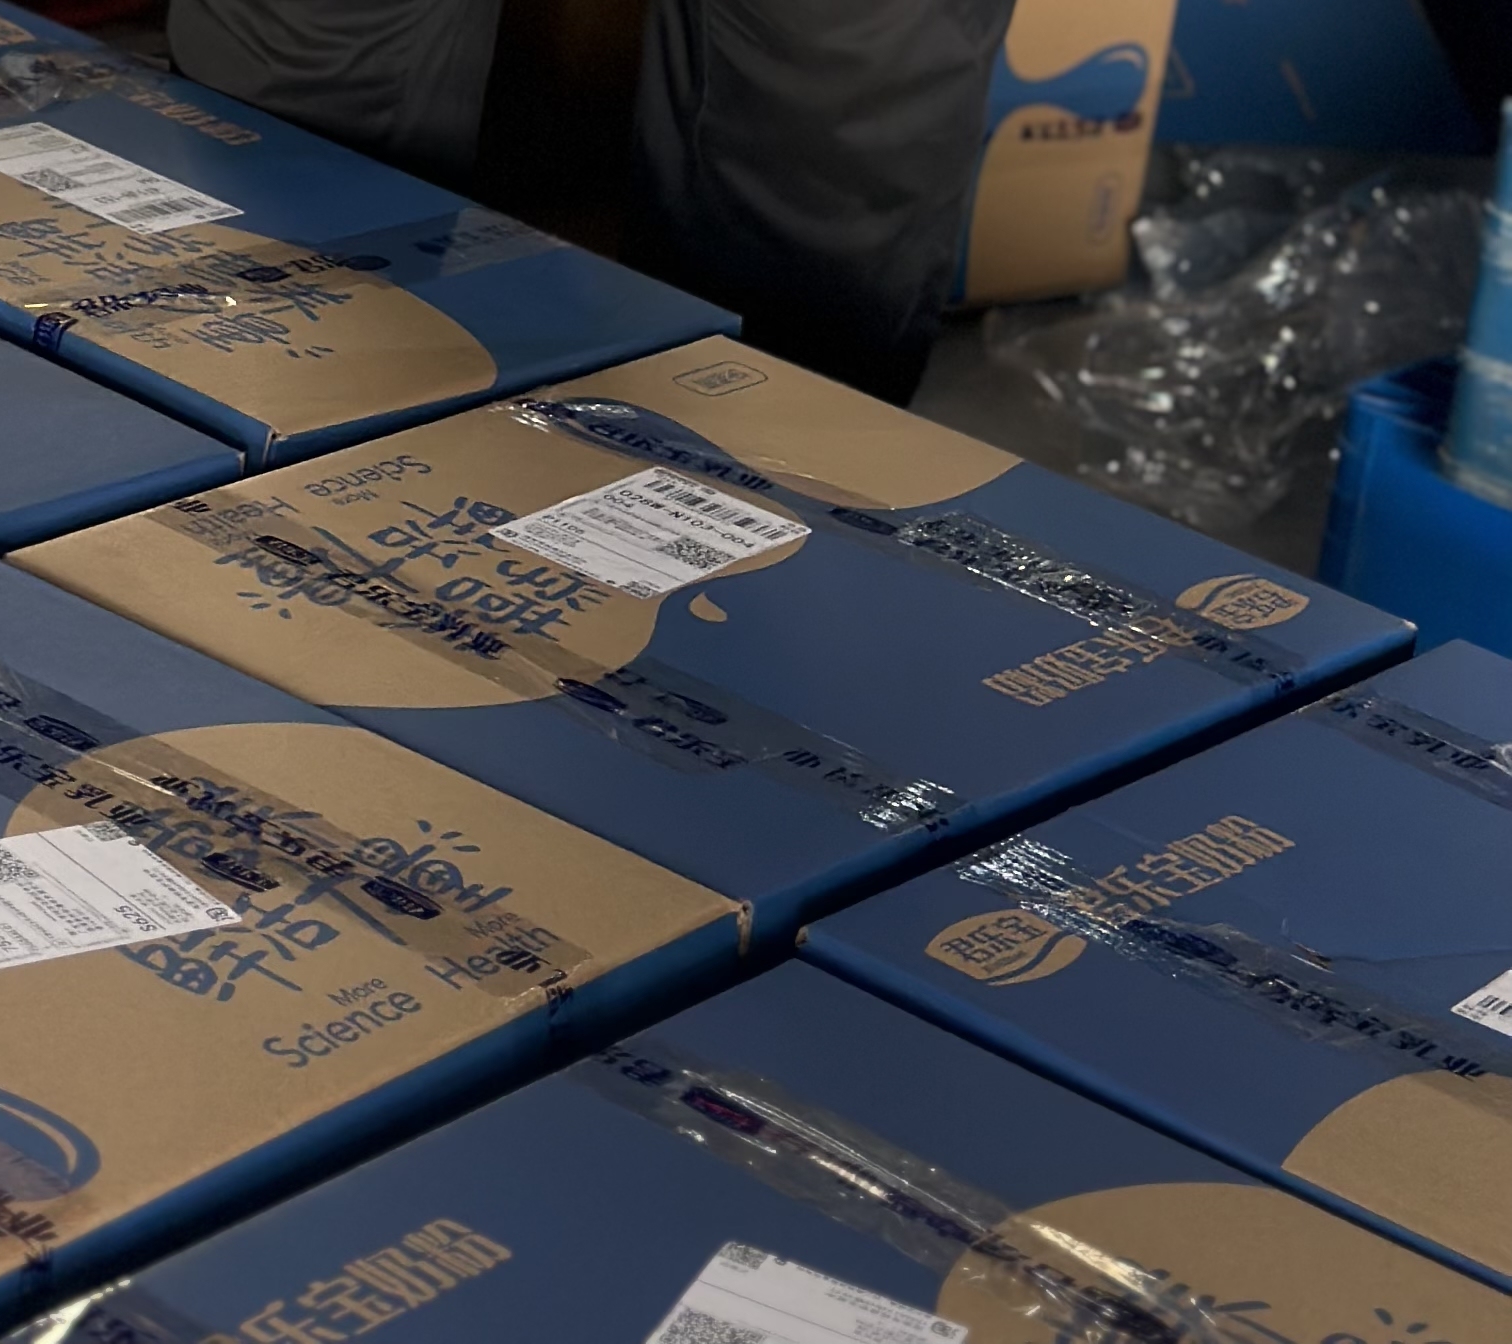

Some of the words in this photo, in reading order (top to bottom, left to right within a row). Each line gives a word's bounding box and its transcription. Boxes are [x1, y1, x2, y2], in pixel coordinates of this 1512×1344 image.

[304, 454, 432, 496] Science
[111, 904, 159, 932] S625
[938, 916, 1048, 966] 君乐宝
[262, 987, 423, 1069] Science
[424, 924, 564, 991] Health
[327, 973, 388, 1009] More
